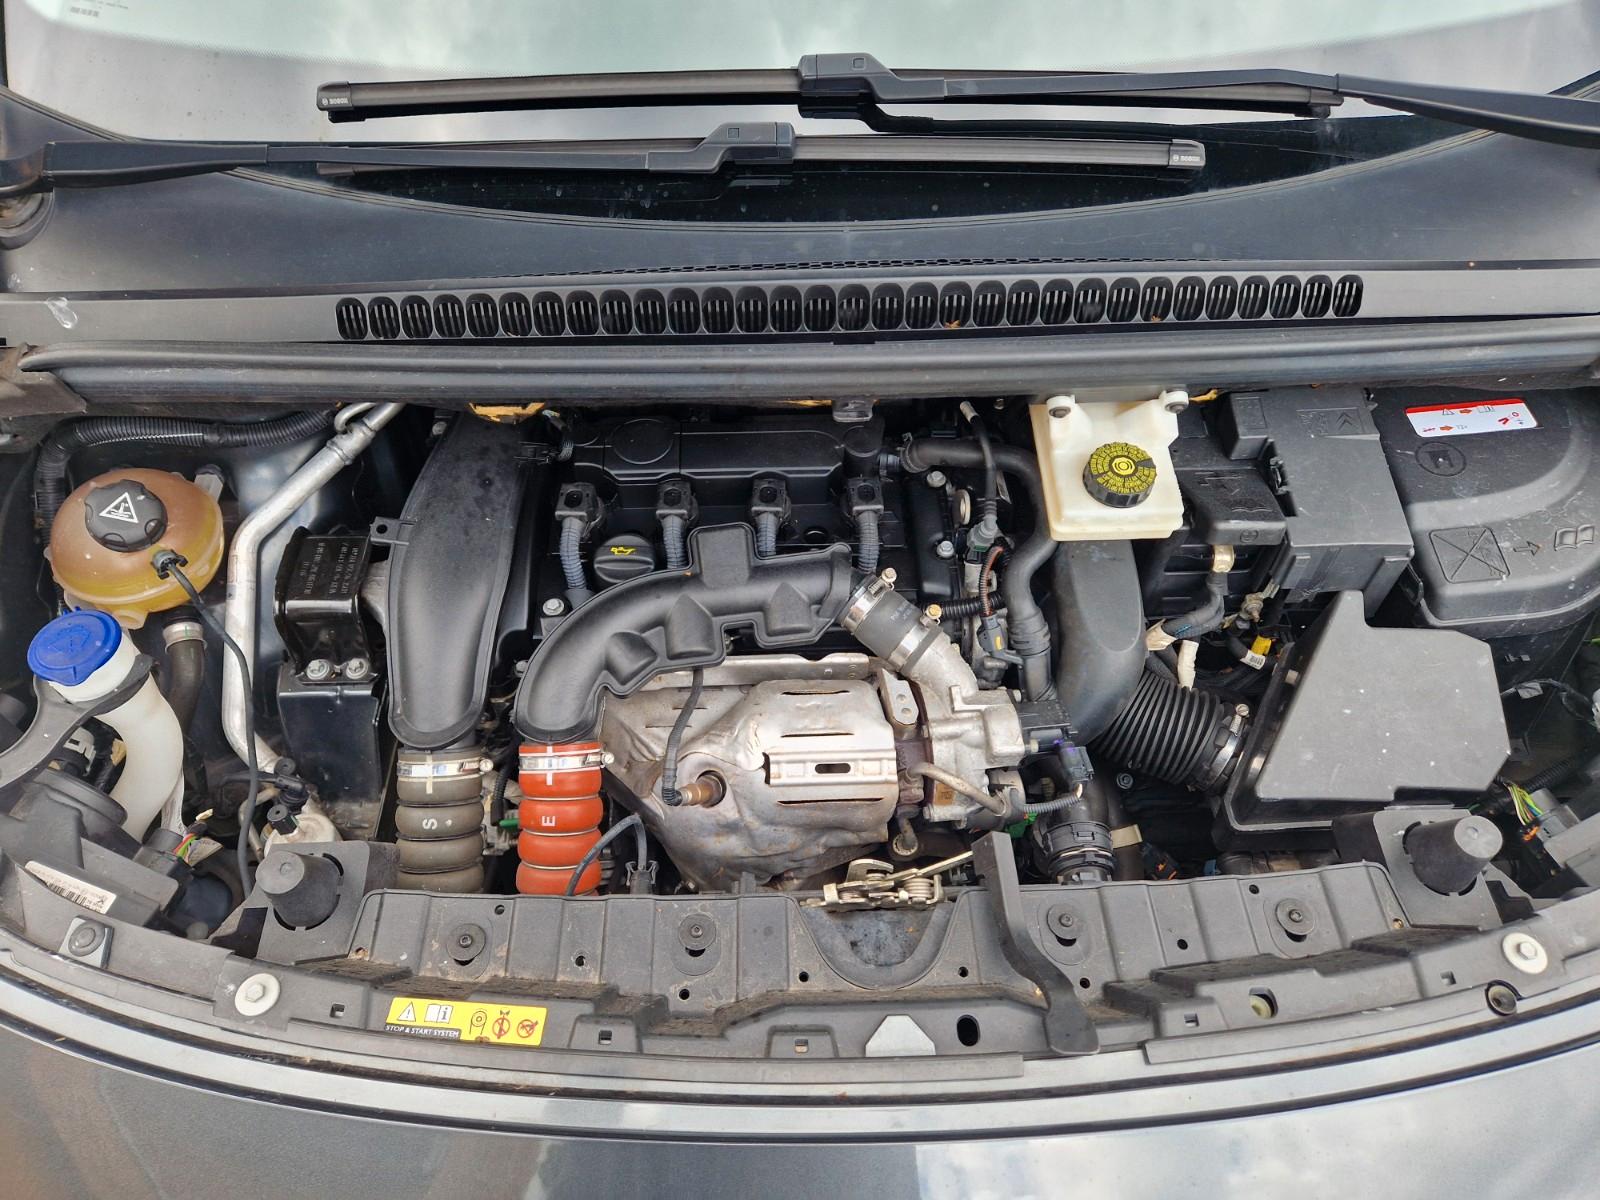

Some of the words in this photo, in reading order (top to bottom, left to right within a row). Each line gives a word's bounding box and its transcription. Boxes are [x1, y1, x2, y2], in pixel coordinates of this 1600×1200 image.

[422, 818, 438, 830] S
[541, 815, 556, 827] E
[386, 1024, 405, 1032] STOP
[411, 1027, 432, 1036] START
[433, 1029, 459, 1038] SYSTEM
